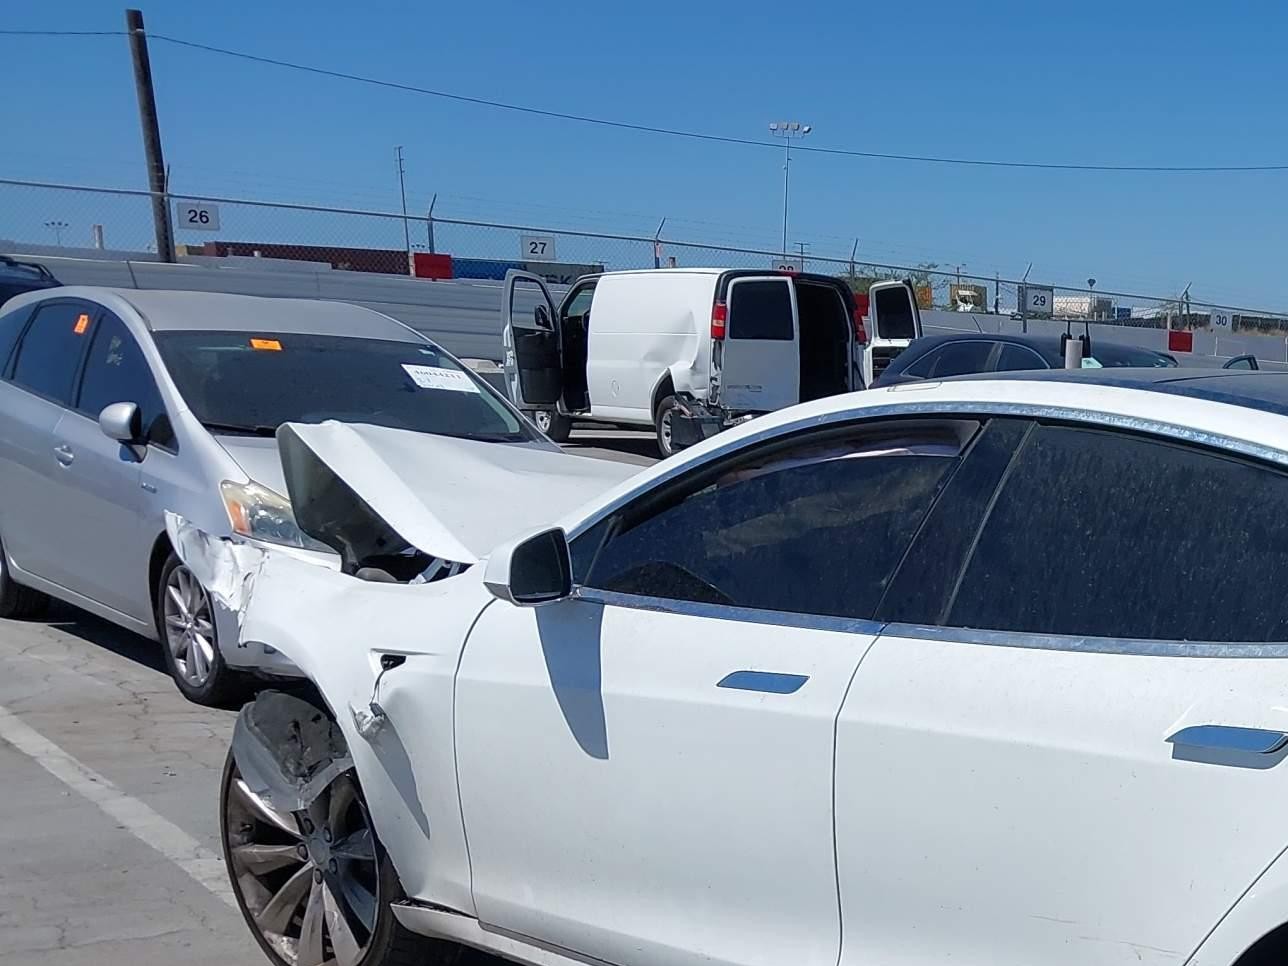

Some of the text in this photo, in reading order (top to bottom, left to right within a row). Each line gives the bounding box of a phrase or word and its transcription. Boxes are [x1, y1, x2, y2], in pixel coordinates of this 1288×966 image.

[188, 209, 209, 224] 26
[529, 241, 547, 255] 27
[1033, 295, 1046, 306] 29
[1216, 314, 1227, 326] 30
